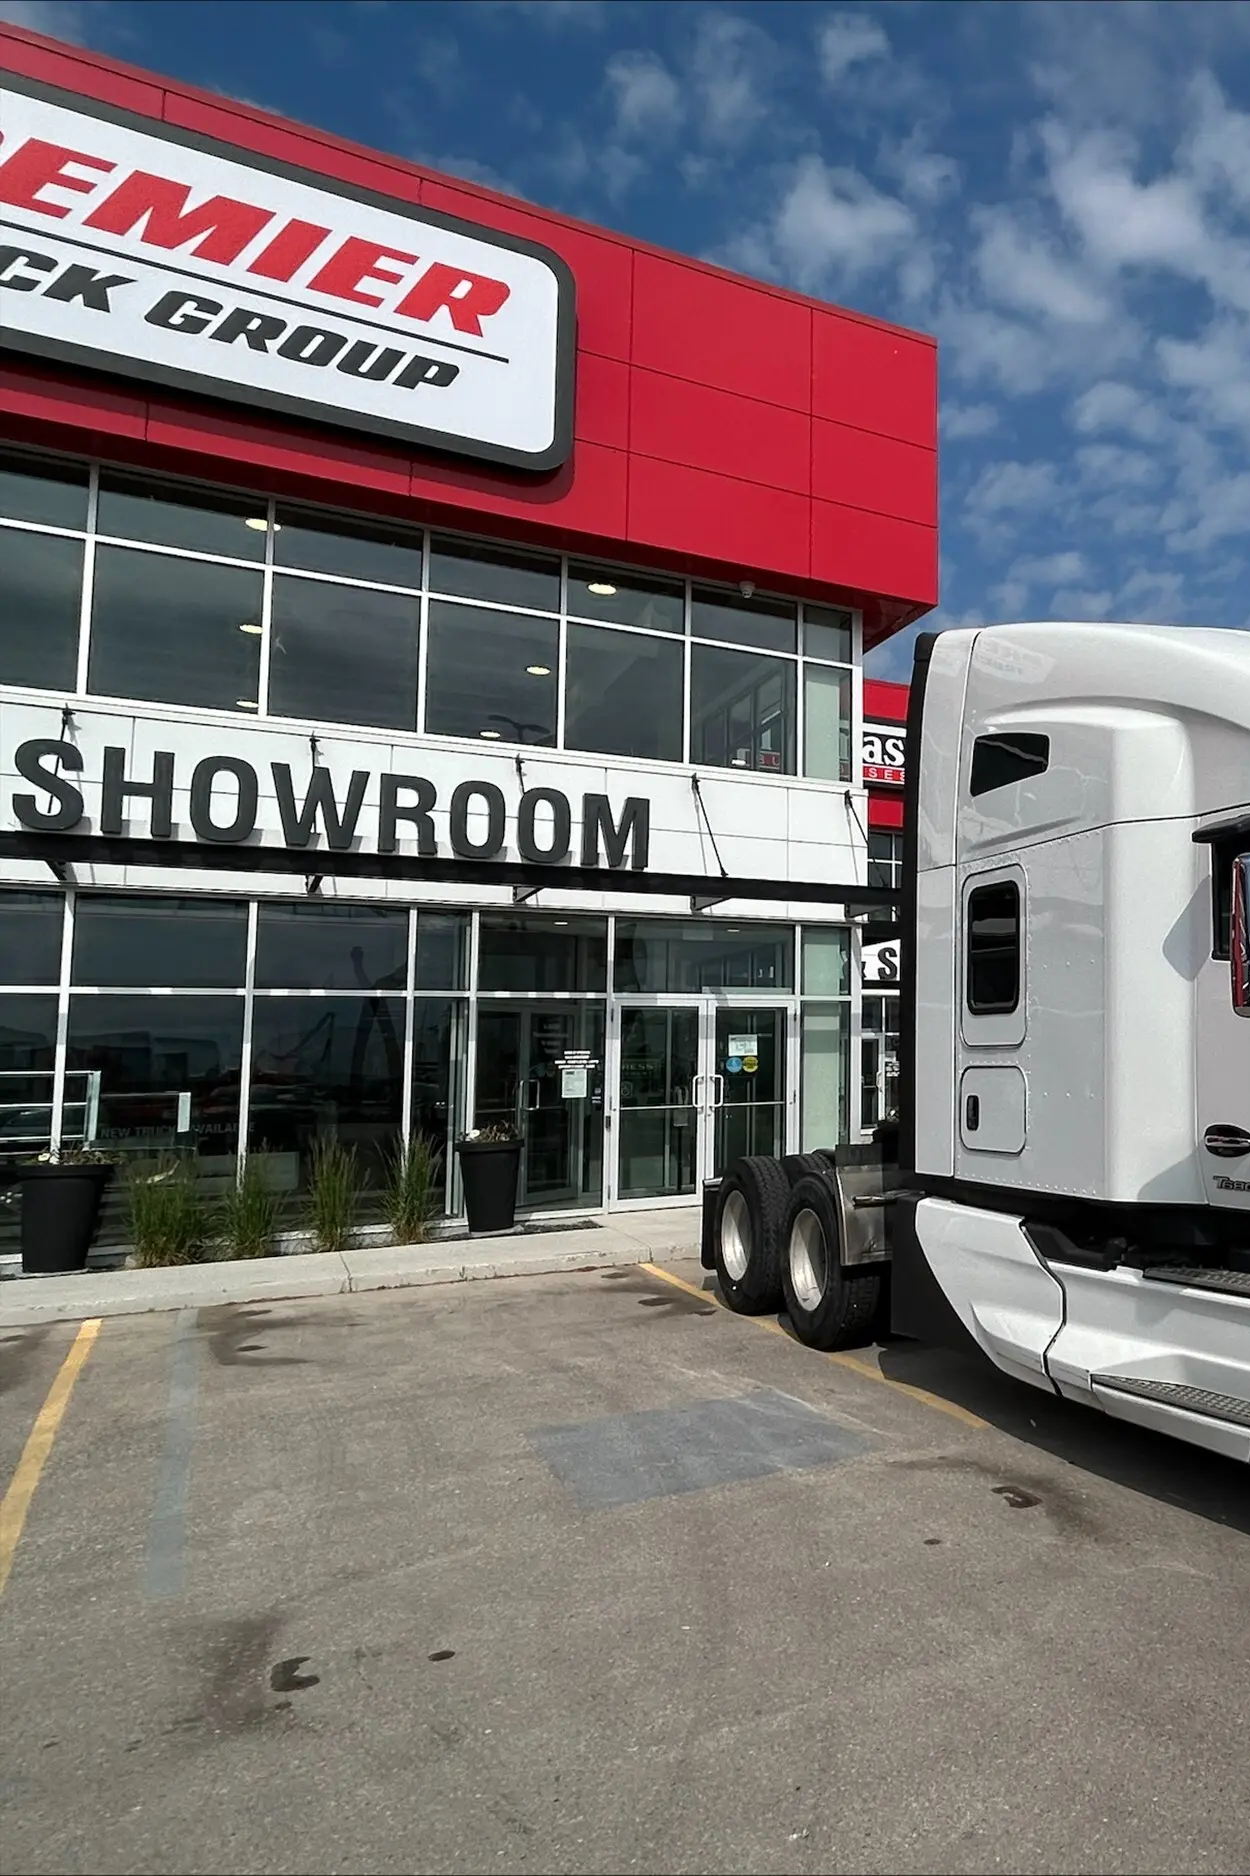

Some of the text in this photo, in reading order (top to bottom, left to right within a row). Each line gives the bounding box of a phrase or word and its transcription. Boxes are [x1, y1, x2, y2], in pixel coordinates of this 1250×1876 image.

[0, 129, 511, 338] EMIER
[143, 290, 461, 390] GROUP
[11, 737, 651, 870] SHOWROOM
